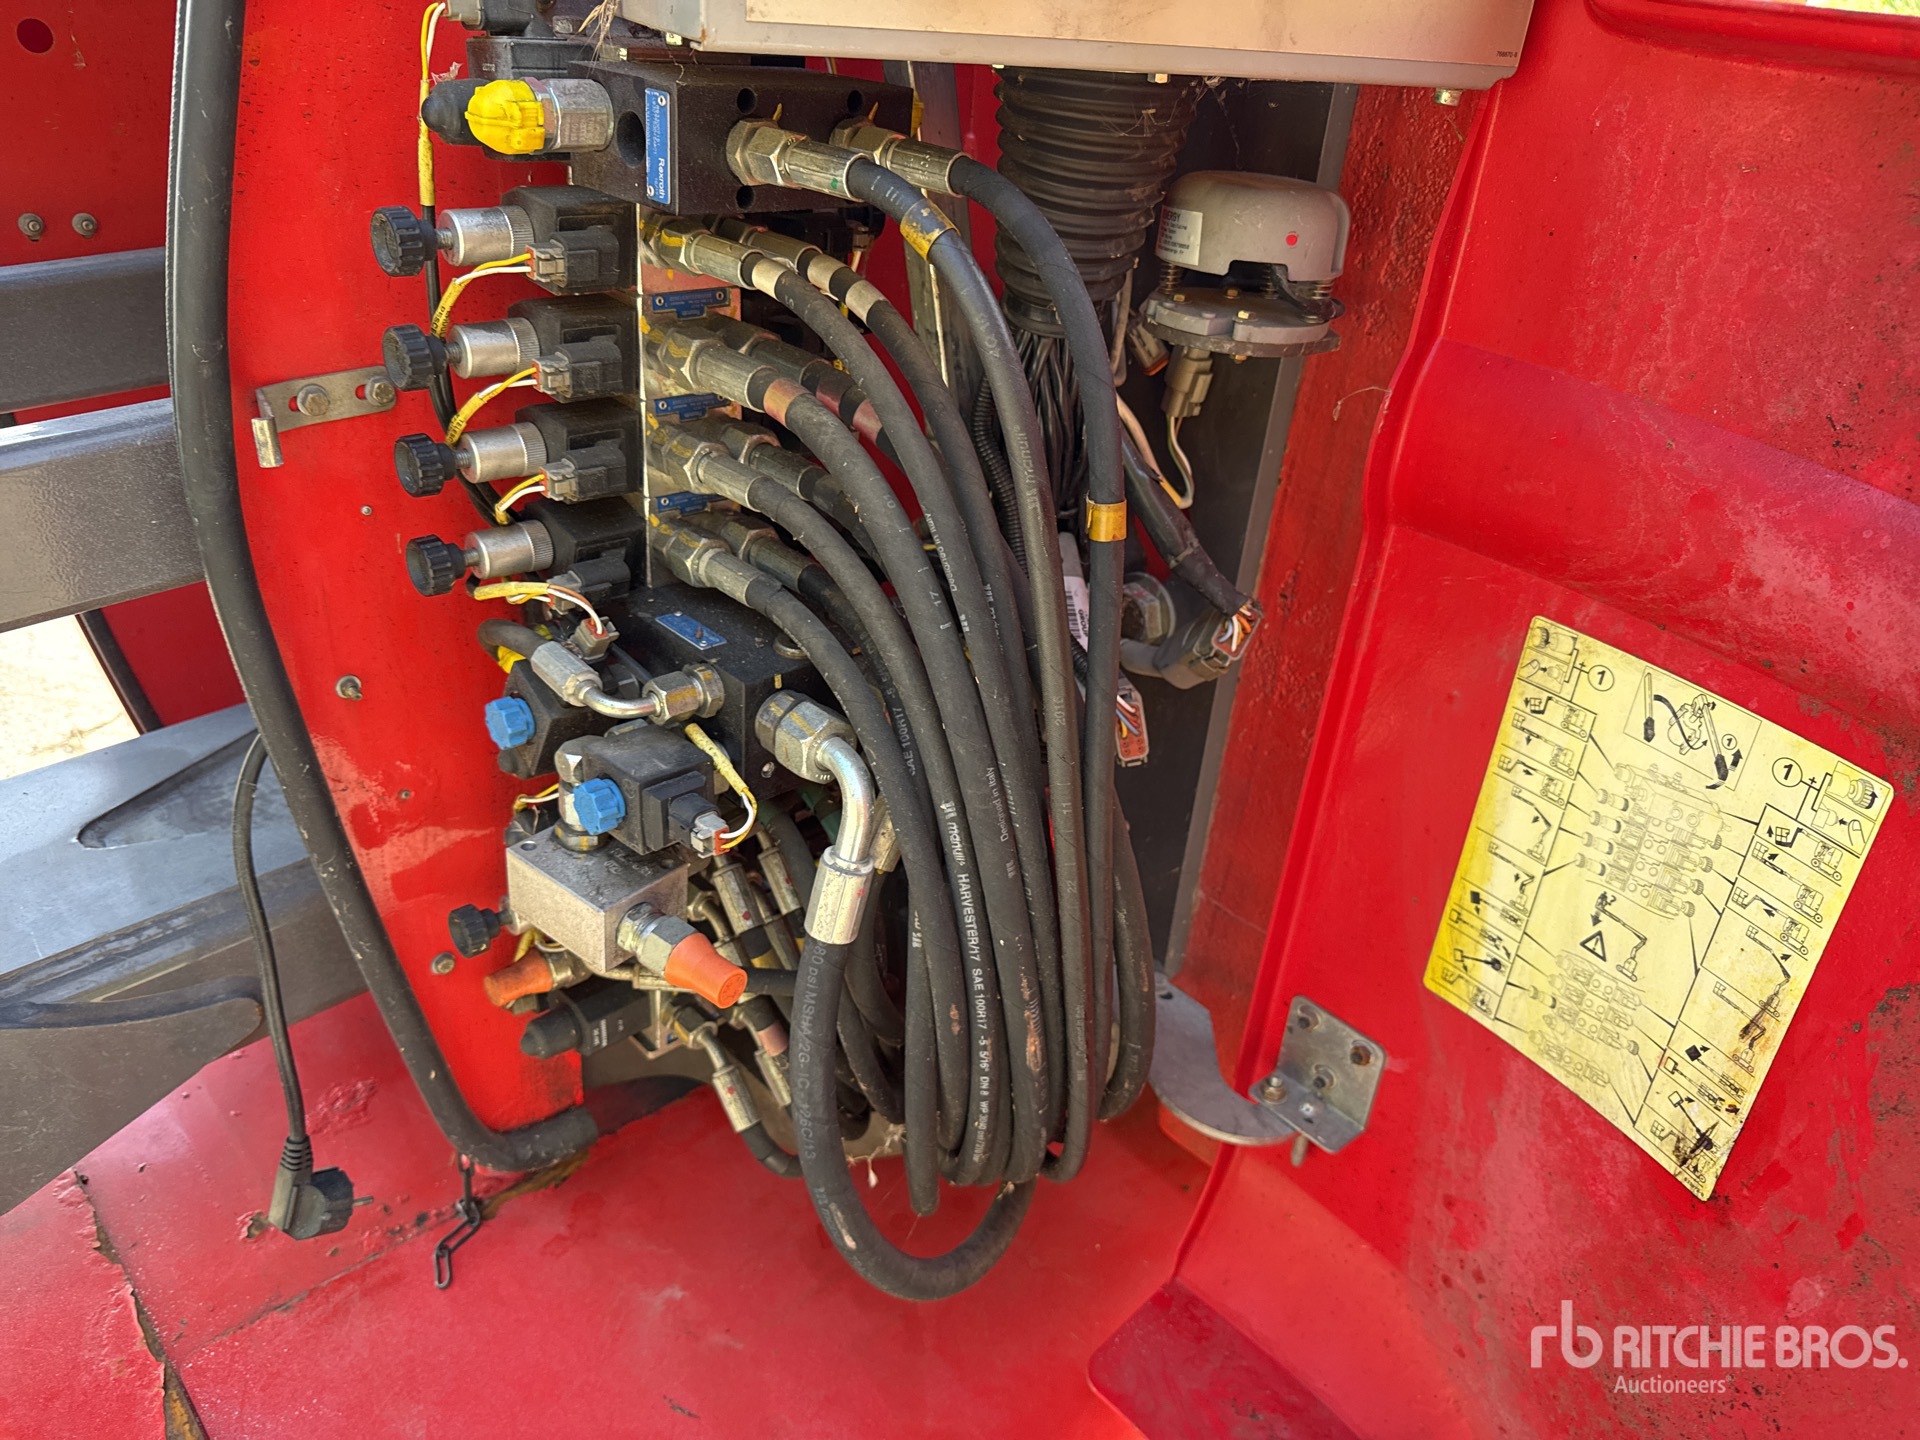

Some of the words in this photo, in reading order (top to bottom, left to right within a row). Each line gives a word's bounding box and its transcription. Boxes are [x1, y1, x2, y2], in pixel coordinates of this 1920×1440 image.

[1597, 670, 1606, 685] 1
[1783, 763, 1794, 781] 1
[957, 873, 981, 962] HARVESTER/17
[972, 968, 985, 991] SAE
[974, 993, 988, 1030] 100R17
[979, 1075, 990, 1090] DN
[978, 1100, 990, 1114] WP
